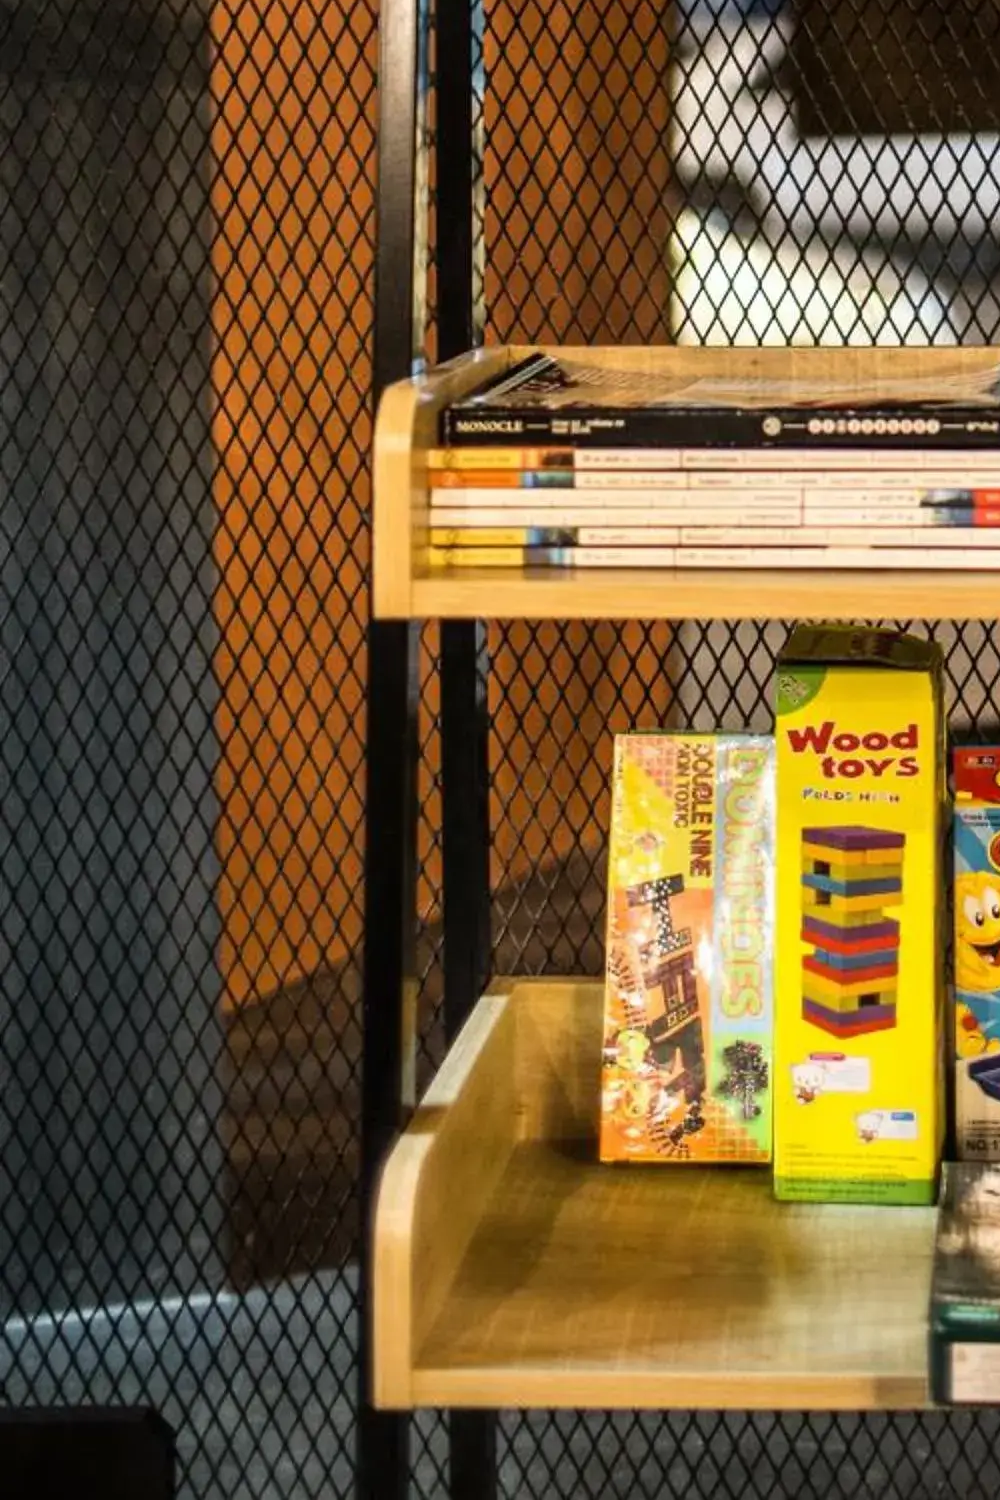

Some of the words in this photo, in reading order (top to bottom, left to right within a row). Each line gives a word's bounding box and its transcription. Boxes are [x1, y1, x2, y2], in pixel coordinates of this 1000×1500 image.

[456, 419, 523, 433] MONOCLE
[676, 744, 691, 777] NON
[787, 721, 919, 755] Wood
[674, 783, 690, 829] TOXIC
[691, 744, 713, 825] DOUBLE
[690, 829, 712, 878] NINE
[722, 747, 769, 1021] DOMINOES
